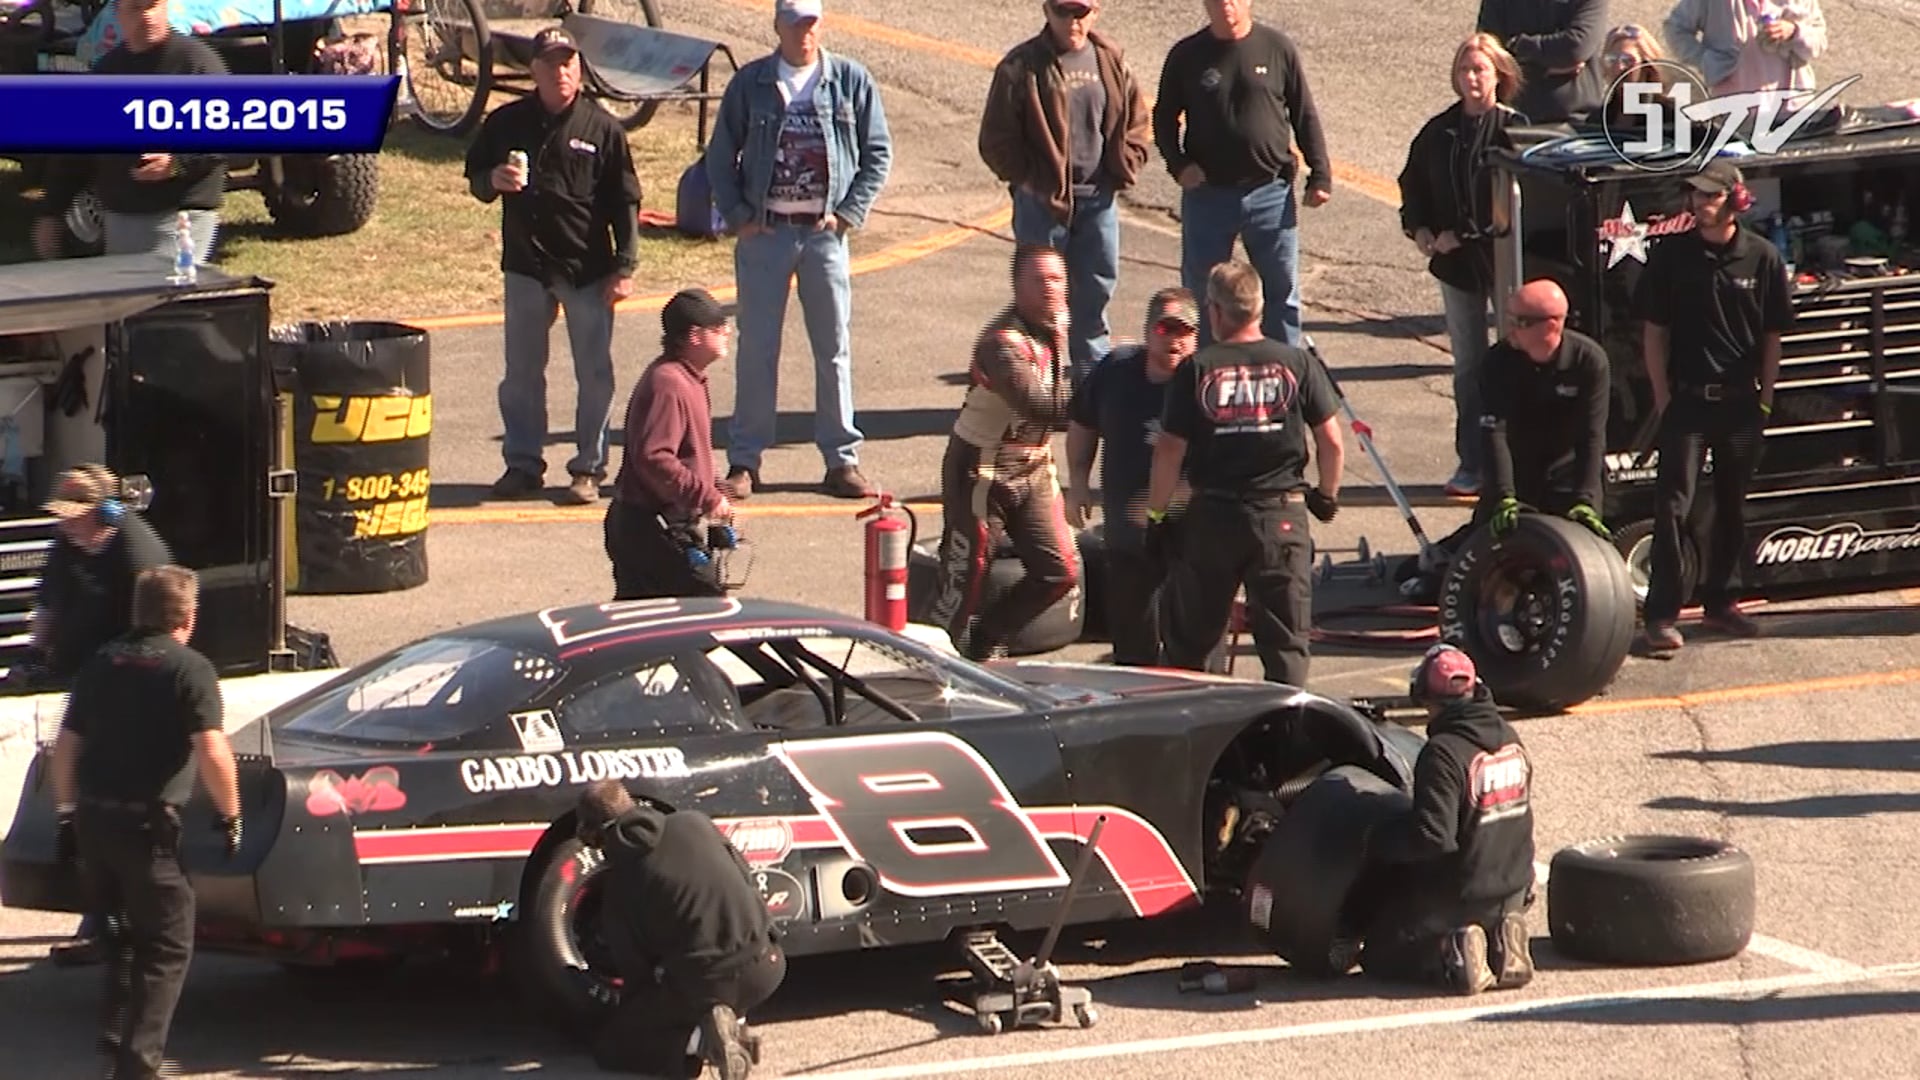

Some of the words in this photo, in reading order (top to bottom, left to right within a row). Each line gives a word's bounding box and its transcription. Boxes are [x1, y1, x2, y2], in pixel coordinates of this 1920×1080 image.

[1757, 532, 1857, 565] MOBLEY
[461, 754, 562, 793] GARBO
[562, 747, 689, 784] LOBSTER
[768, 731, 1070, 897] 8
